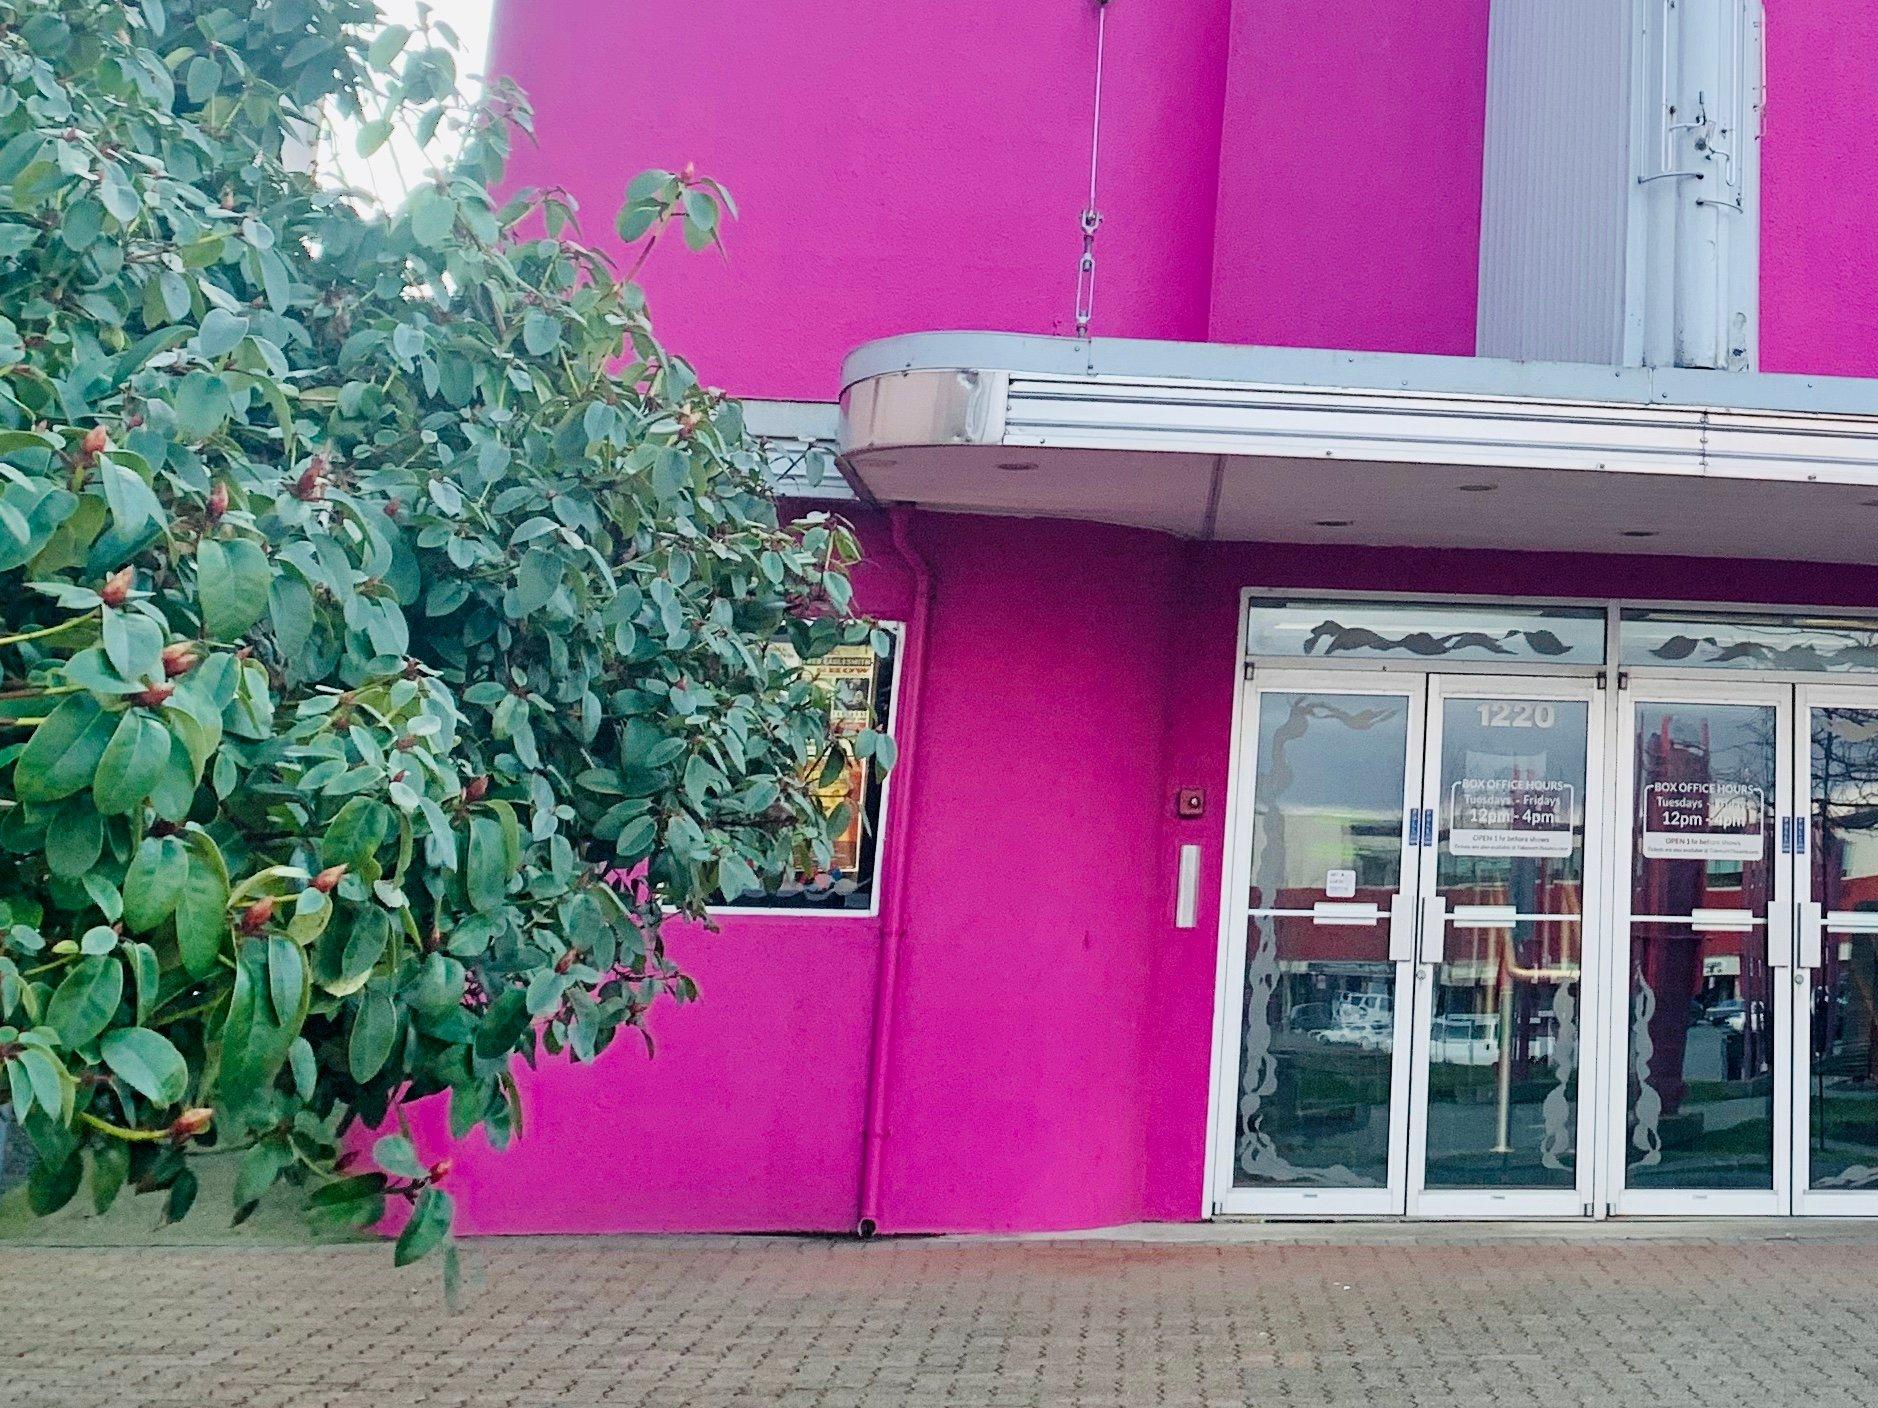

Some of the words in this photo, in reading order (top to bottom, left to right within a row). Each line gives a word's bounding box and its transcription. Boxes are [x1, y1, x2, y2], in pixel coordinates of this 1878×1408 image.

[1476, 702, 1555, 728] 1220
[1462, 778, 1485, 789] BOX
[1487, 779, 1524, 790] OFFICE
[1525, 780, 1563, 791] HOURS
[1654, 782, 1677, 793] BOX
[1679, 782, 1715, 794] OFFICE
[1717, 784, 1754, 795] HOURS
[1465, 794, 1511, 808] Tuesdays
[1523, 794, 1561, 809] Fridays
[1656, 796, 1703, 810] Tuesdays
[1470, 808, 1511, 824] 12pm
[1522, 809, 1554, 826] 4pm
[1662, 810, 1703, 828] 12pm
[1714, 813, 1746, 830] 4pm
[1472, 834, 1492, 842] OPEN
[1507, 835, 1529, 843] before
[1665, 837, 1686, 845] OPEN
